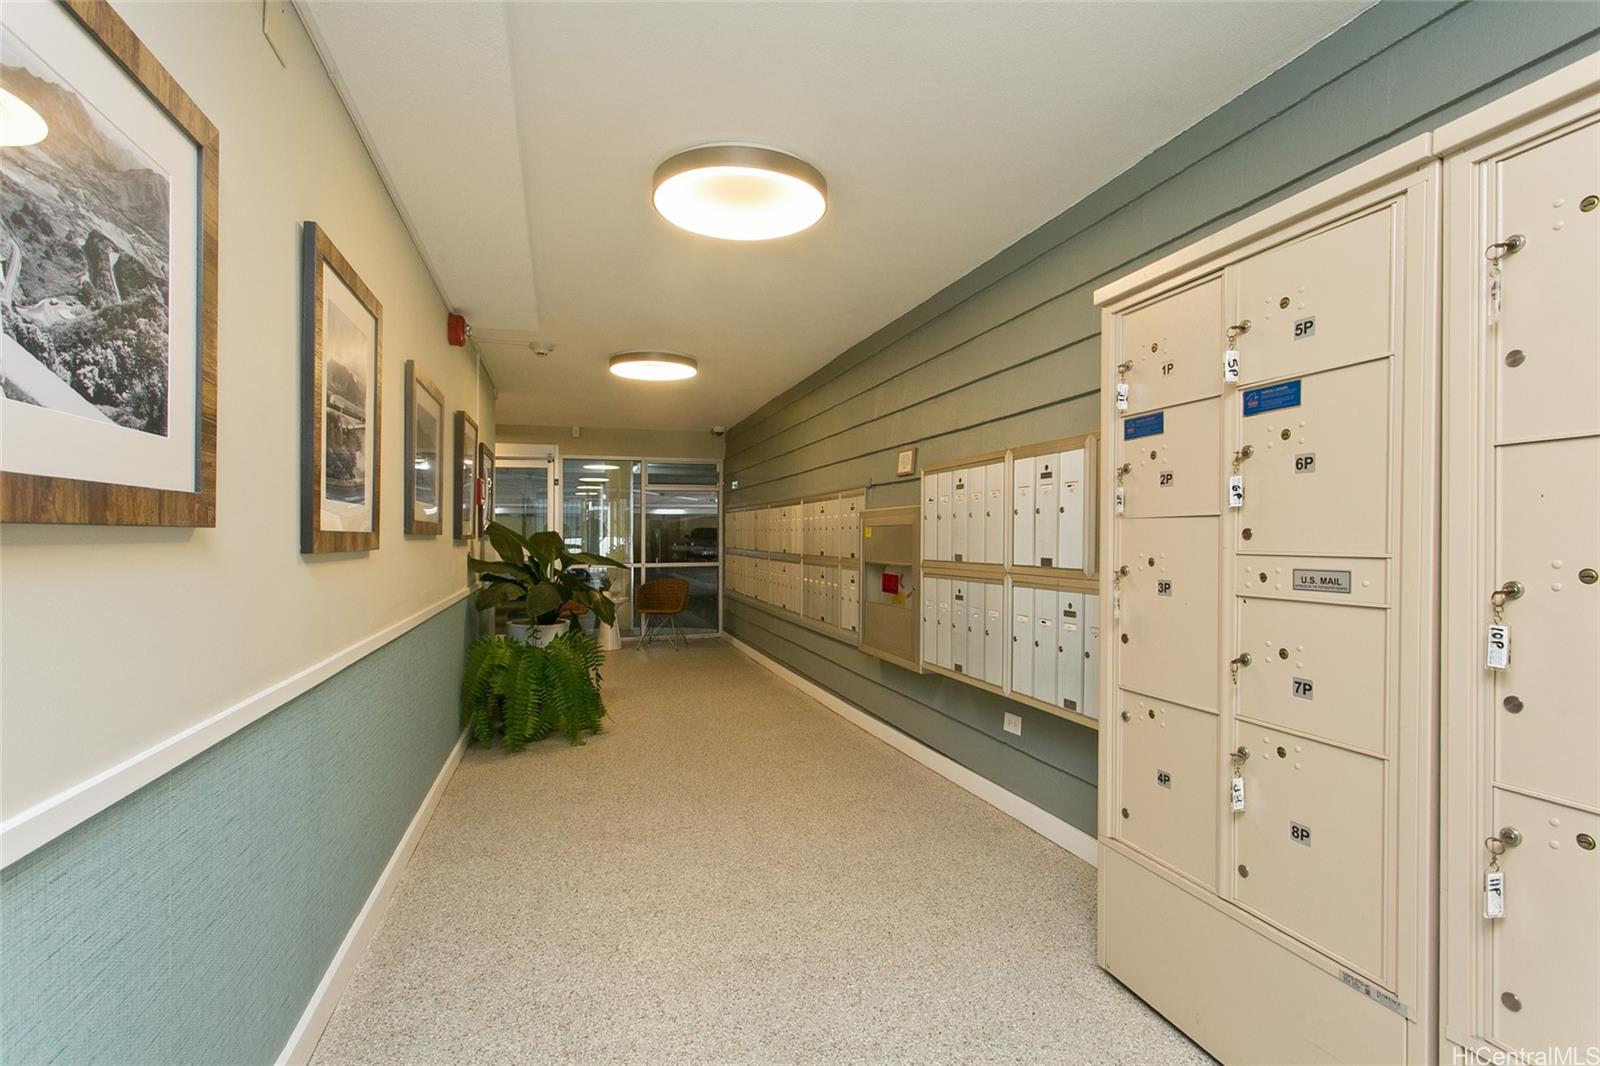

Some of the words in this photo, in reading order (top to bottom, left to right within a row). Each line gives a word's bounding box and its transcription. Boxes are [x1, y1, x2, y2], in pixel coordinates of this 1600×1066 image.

[1294, 320, 1314, 337] 5P
[1162, 364, 1174, 376] 1P
[1295, 455, 1313, 471] 6P
[1159, 473, 1172, 486] 2P
[1157, 582, 1171, 594] 3P
[1301, 576, 1317, 584] U.S.
[1320, 577, 1342, 585] MAIL
[1491, 627, 1504, 649] 10P
[1294, 680, 1312, 696] 7P
[1158, 772, 1171, 785] 4P
[1292, 825, 1310, 841] 8P
[1489, 879, 1501, 896] 11P
